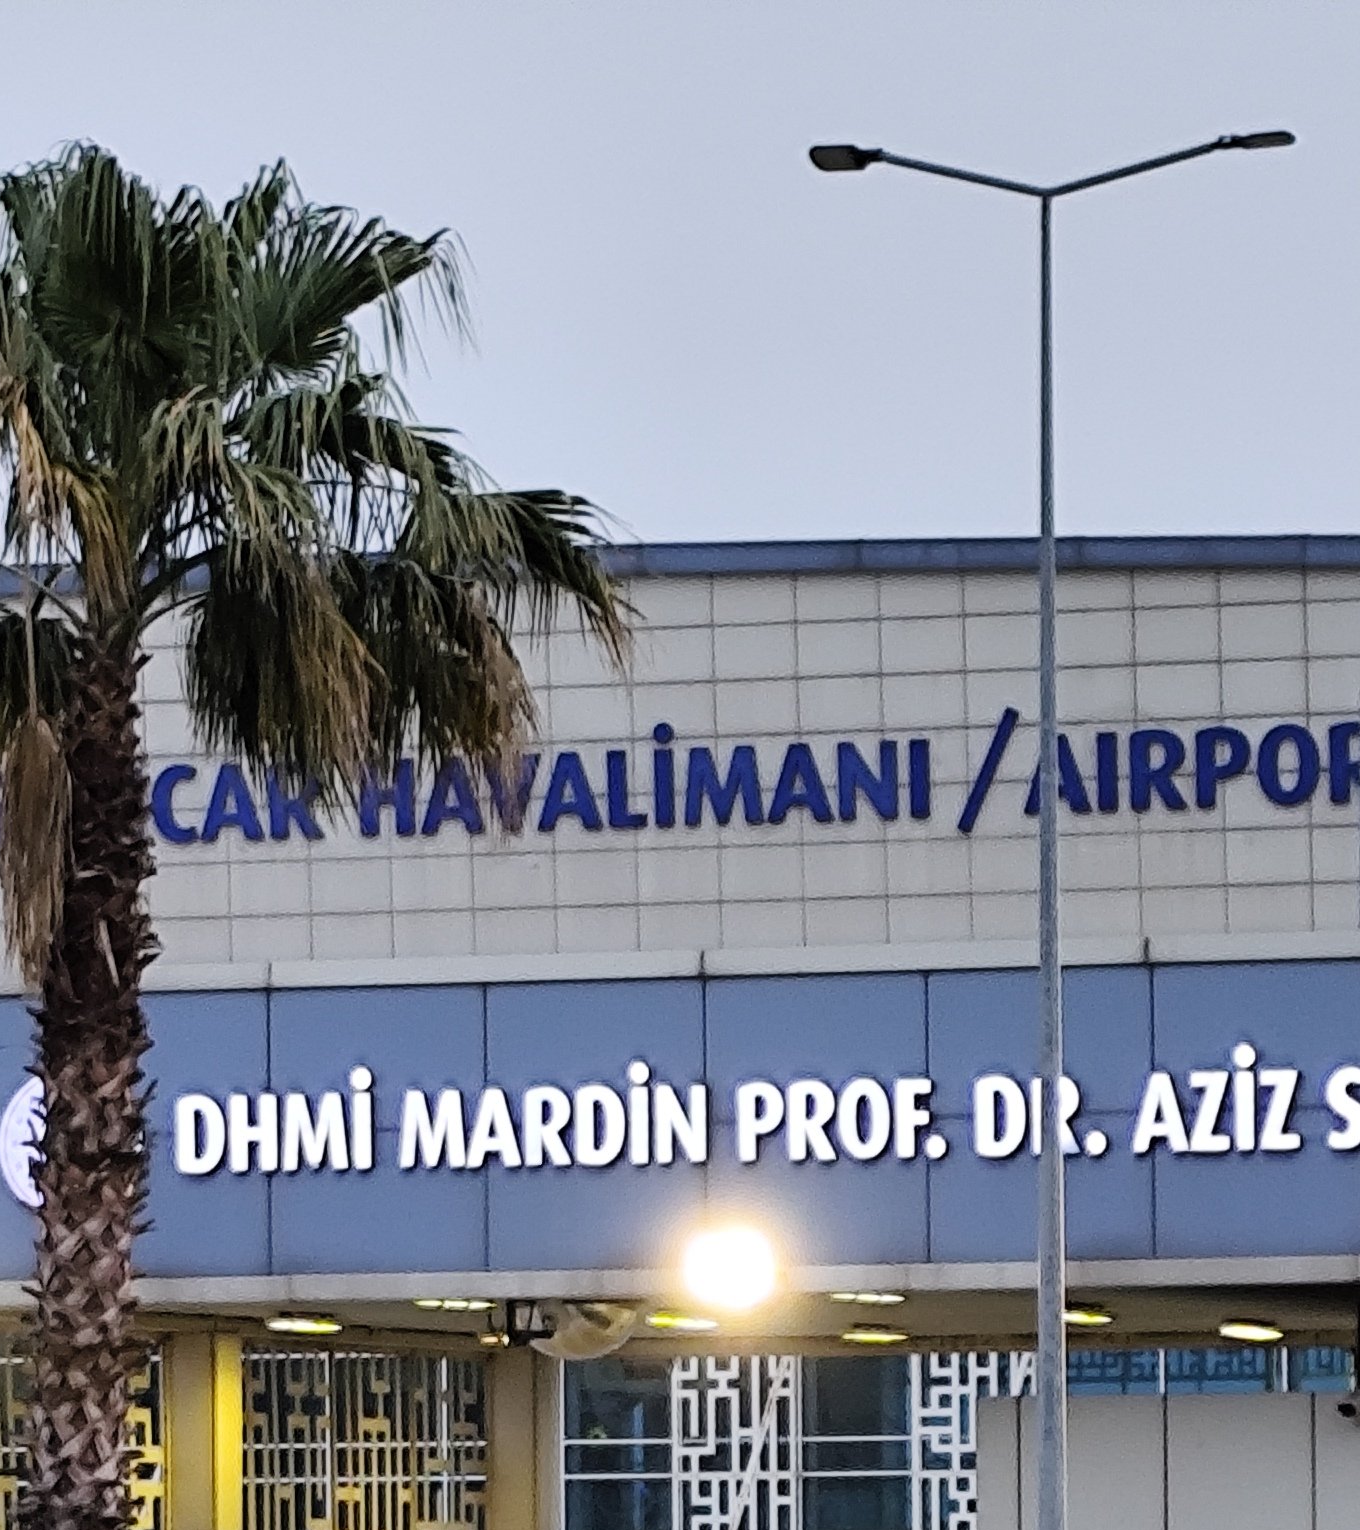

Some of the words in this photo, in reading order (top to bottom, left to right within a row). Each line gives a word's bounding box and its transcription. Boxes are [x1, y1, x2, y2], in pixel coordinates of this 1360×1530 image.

[359, 722, 931, 839] HAVALİMANI
[956, 706, 1020, 834] /
[173, 1063, 373, 1175] DHMİ
[399, 1058, 707, 1171] MARDİN
[736, 1075, 948, 1163] PROF.
[1132, 1041, 1302, 1155] AZİZ
